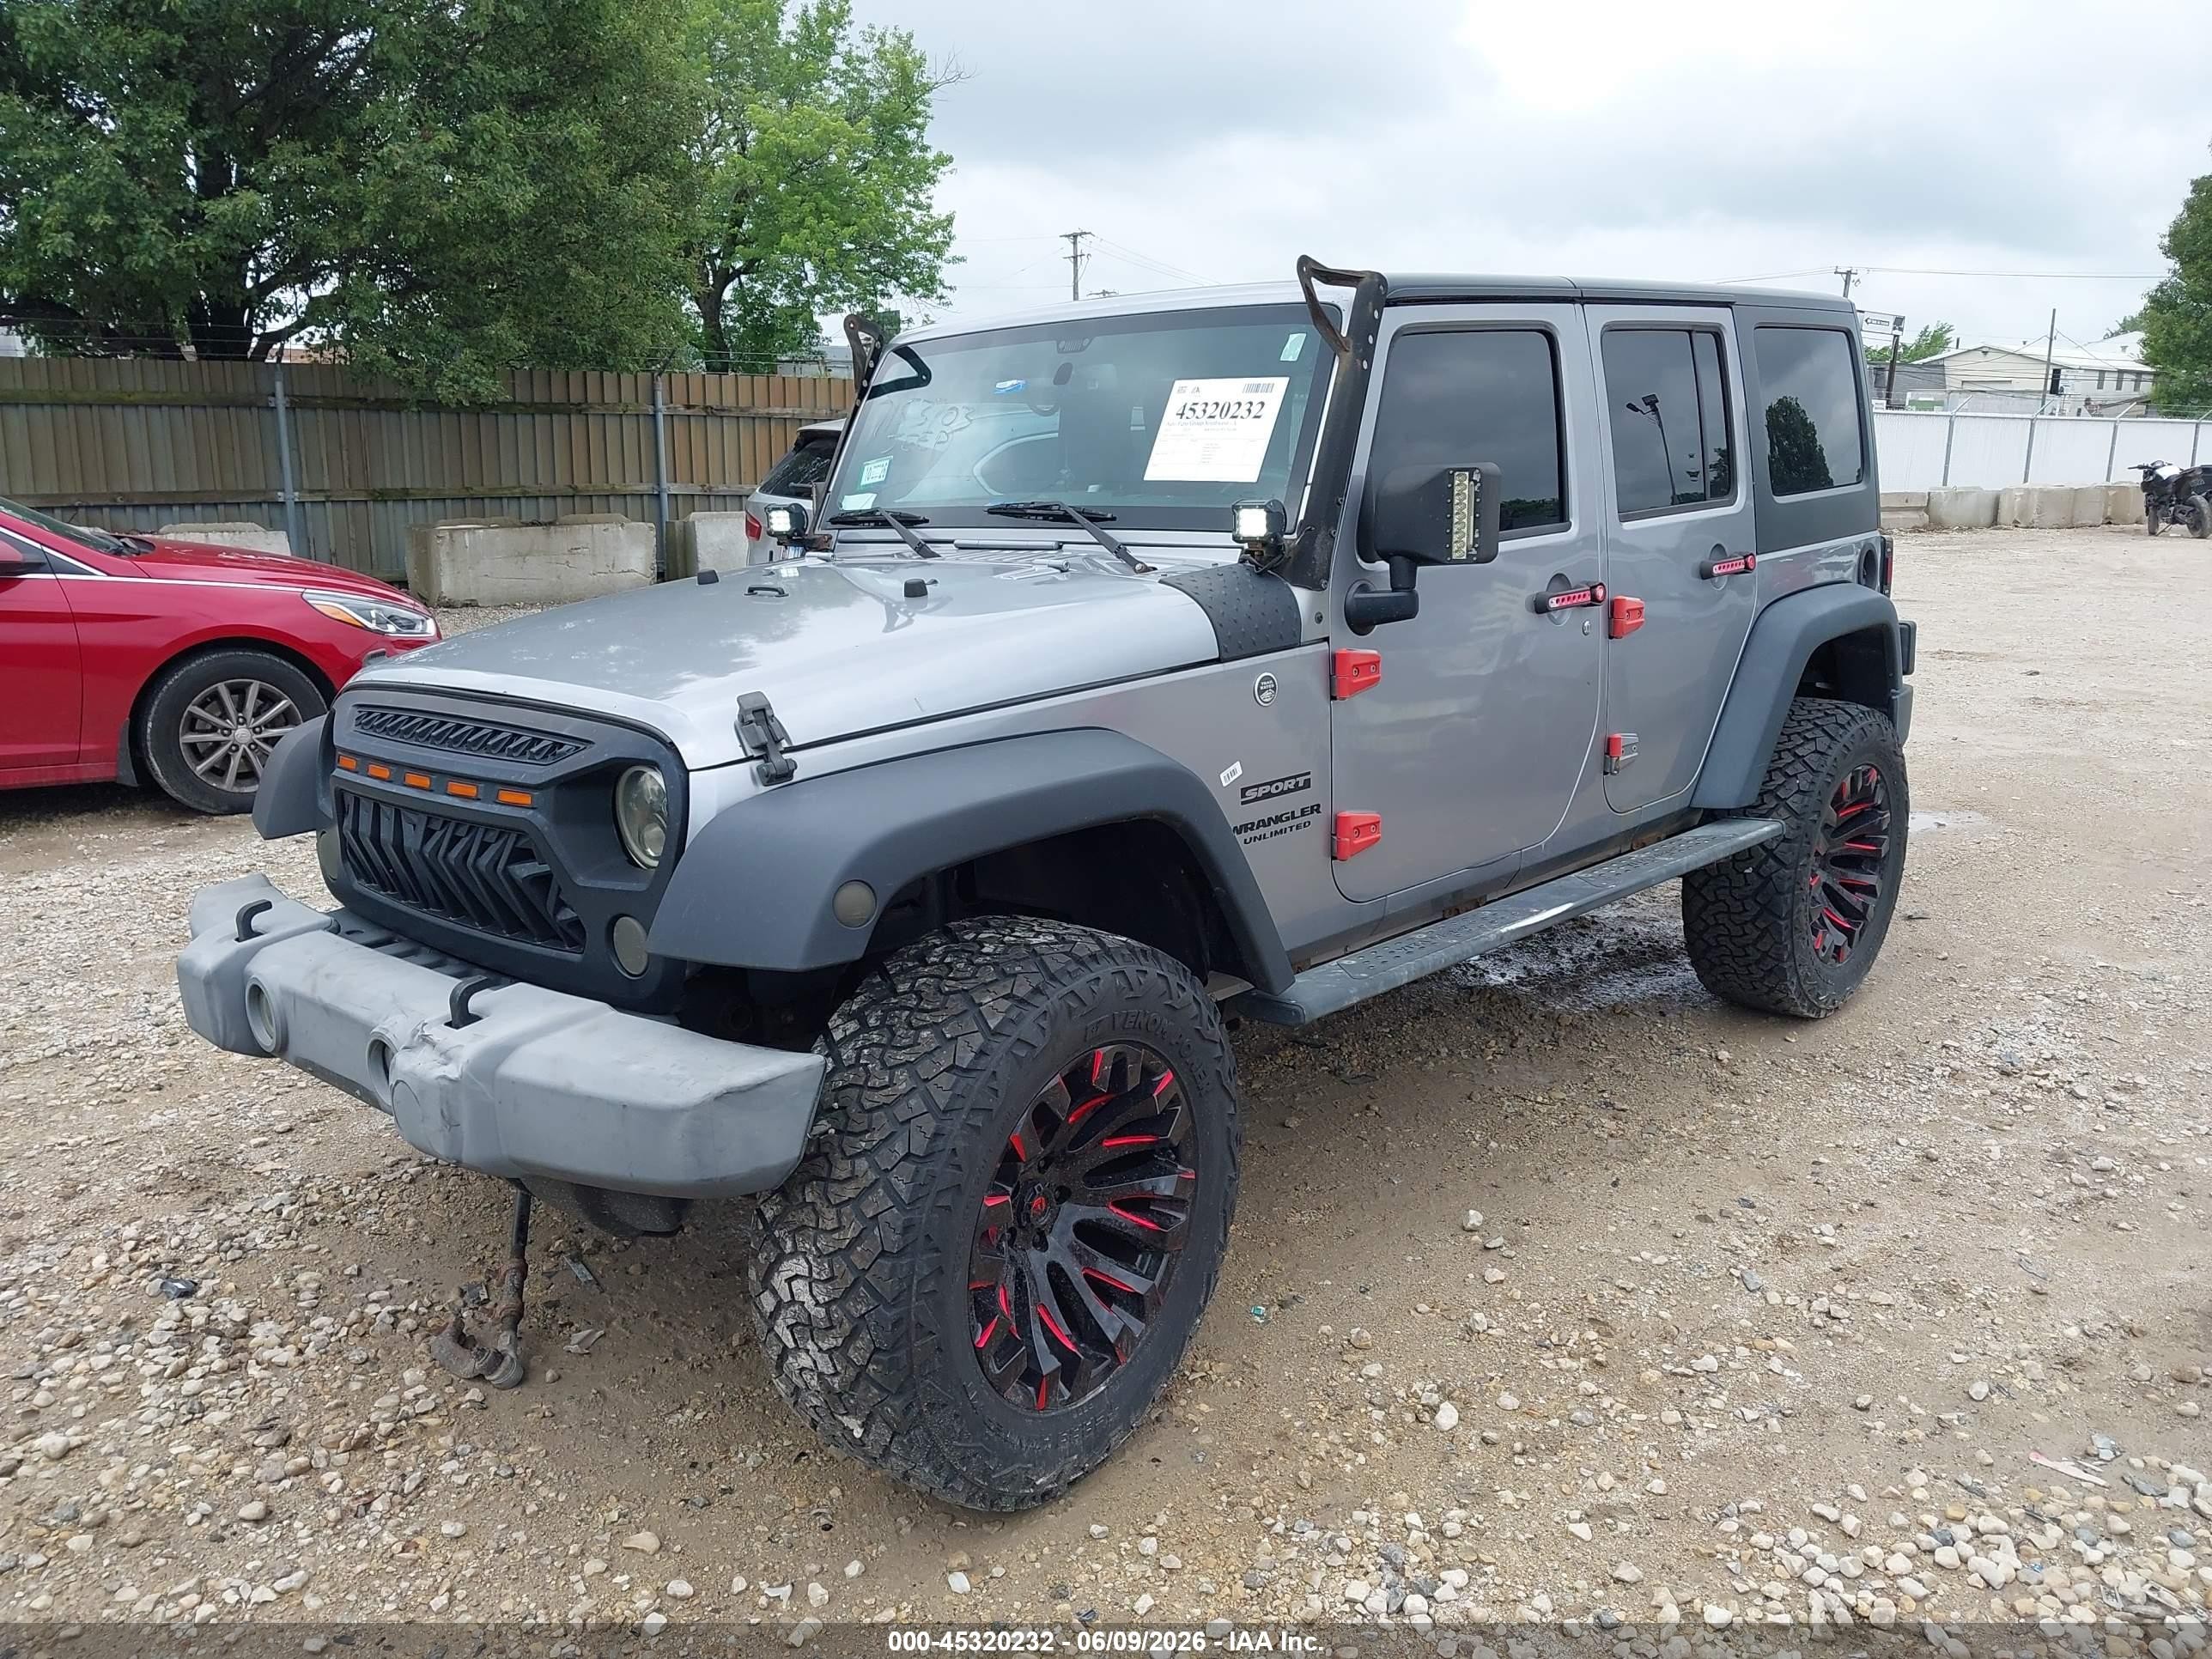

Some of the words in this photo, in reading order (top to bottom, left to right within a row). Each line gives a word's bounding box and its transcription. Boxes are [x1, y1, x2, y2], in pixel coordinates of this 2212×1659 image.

[1176, 400, 1267, 420] 45320232
[1243, 775, 1310, 801] SPORT
[1243, 820, 1311, 845] UNLIMITED
